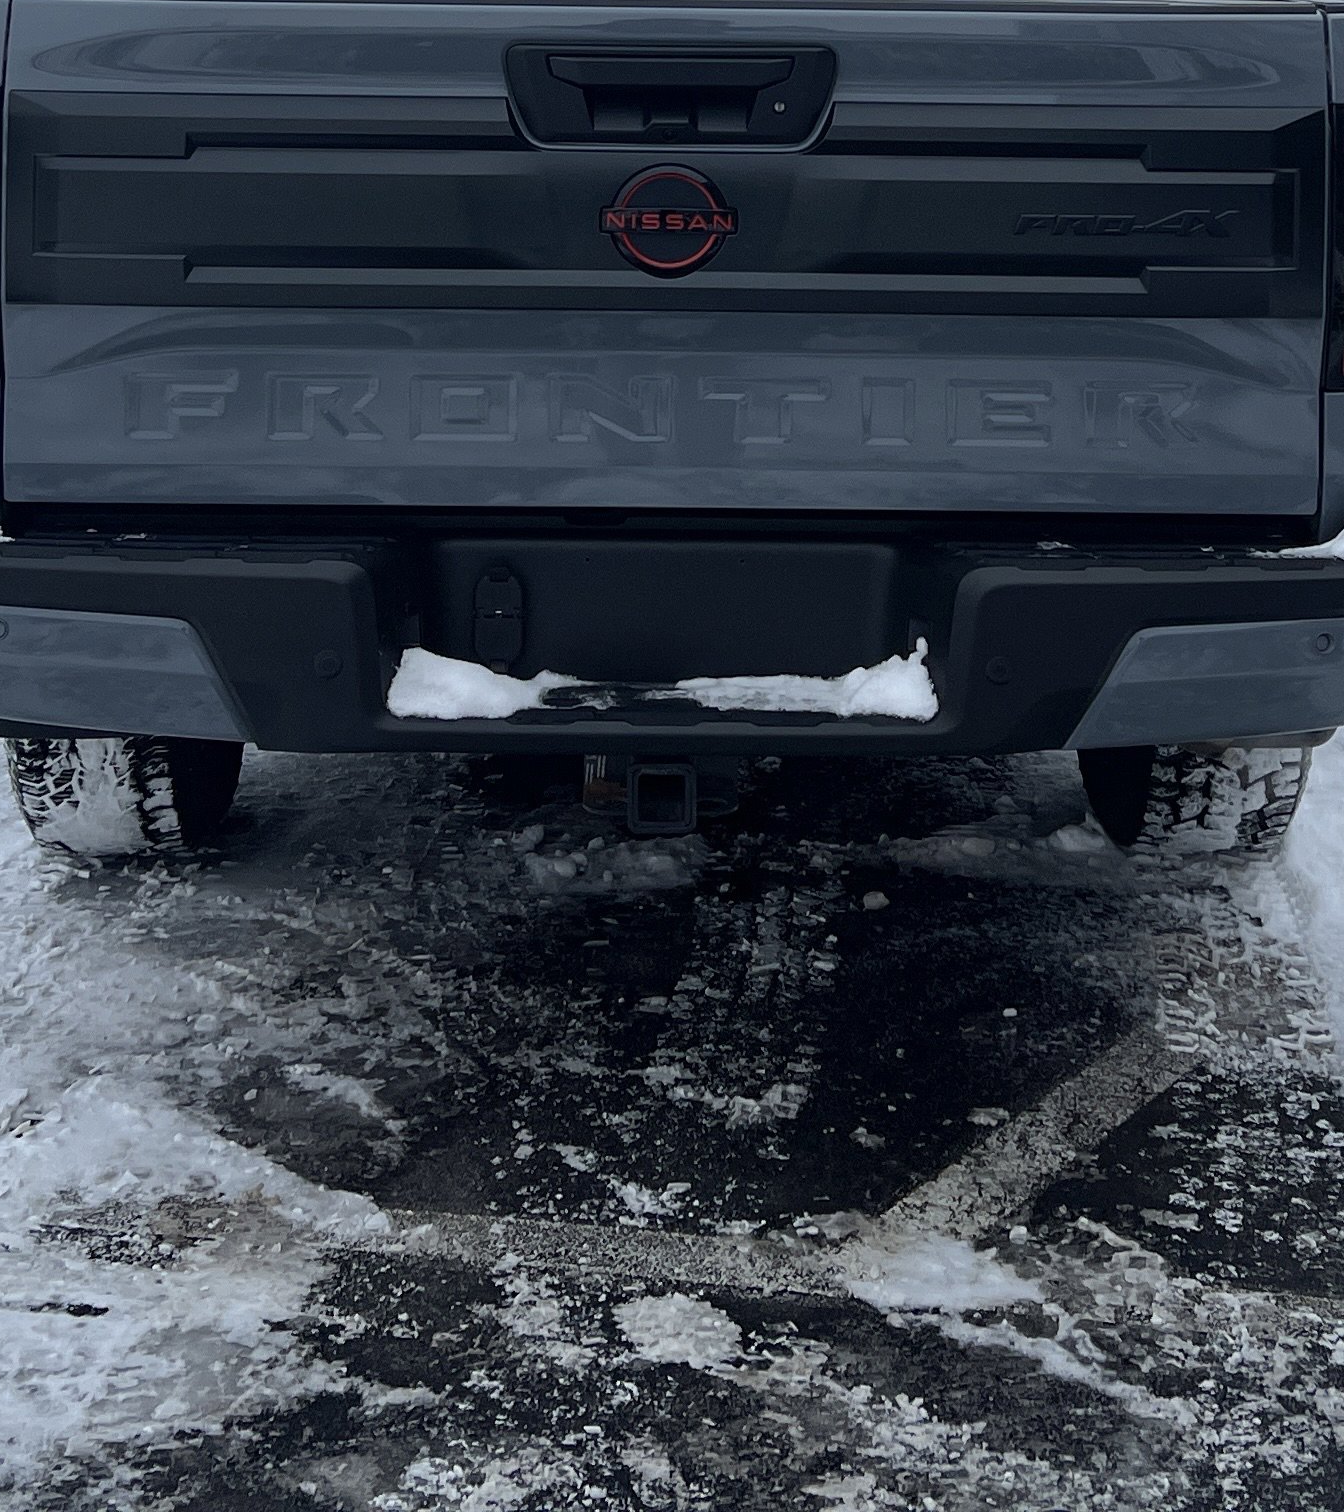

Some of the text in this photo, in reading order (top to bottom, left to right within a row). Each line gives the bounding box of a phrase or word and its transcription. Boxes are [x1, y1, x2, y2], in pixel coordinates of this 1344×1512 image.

[606, 211, 733, 231] NISSAN
[1013, 209, 1241, 237] PRO-4X
[124, 368, 1200, 450] FRONTIER
